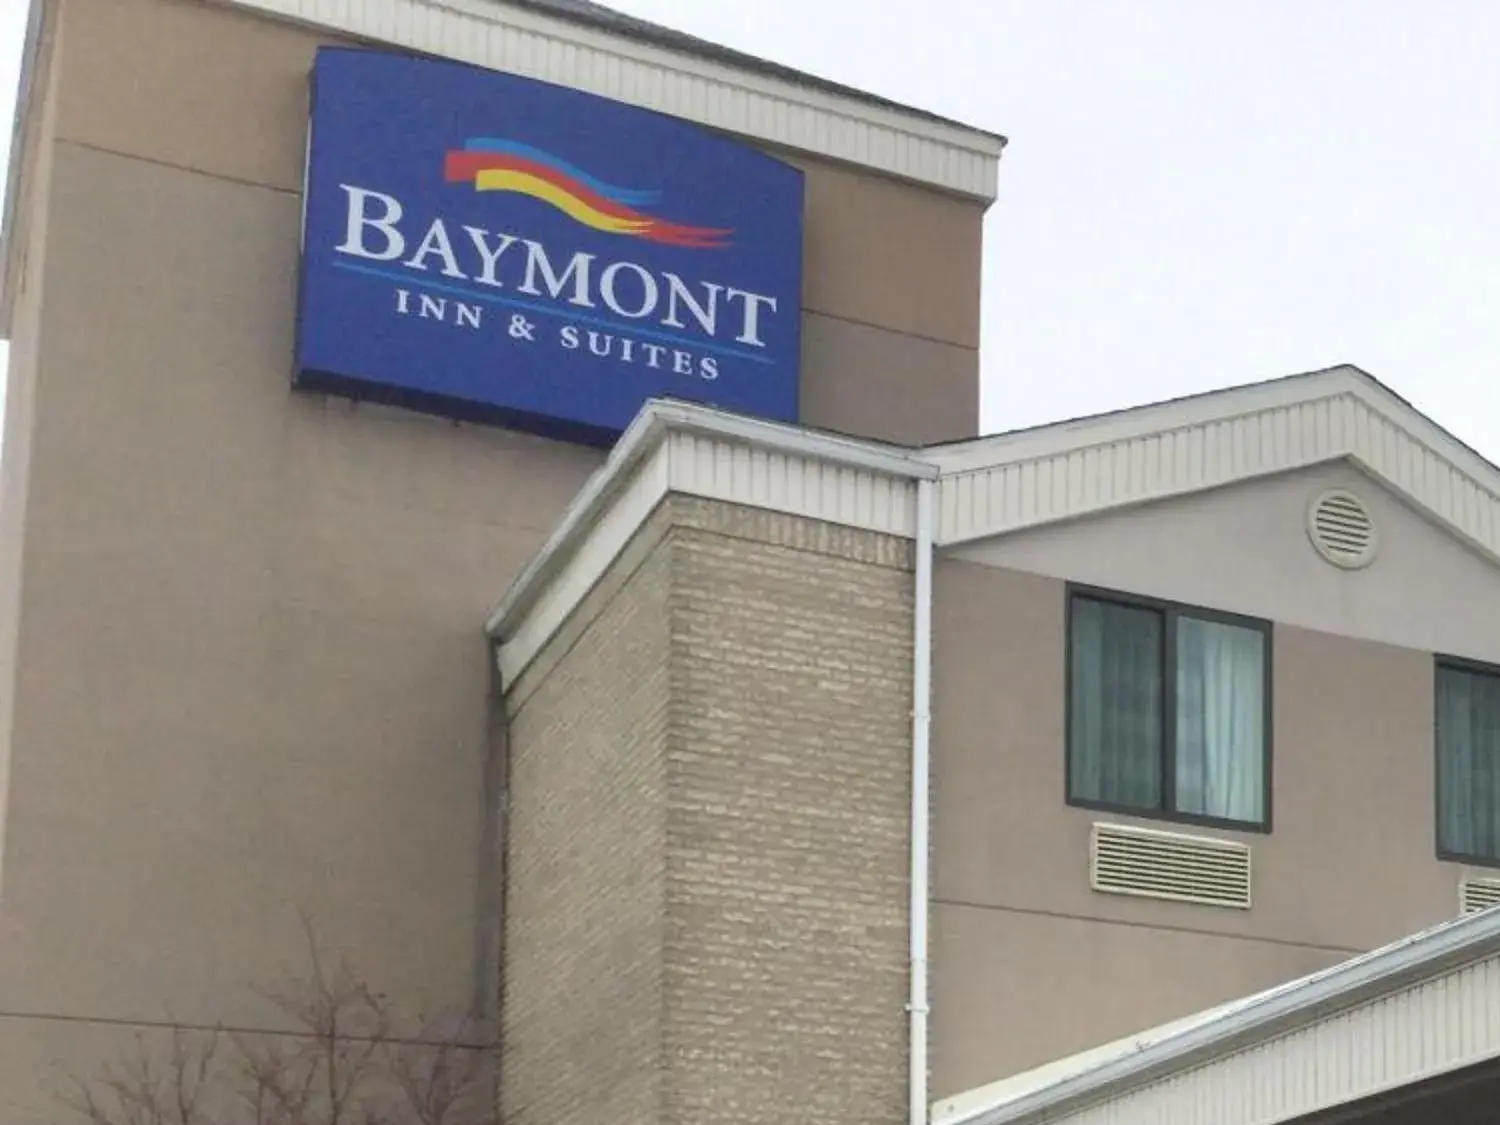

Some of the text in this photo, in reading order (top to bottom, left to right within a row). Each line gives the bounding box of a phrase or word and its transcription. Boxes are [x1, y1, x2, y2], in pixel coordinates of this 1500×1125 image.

[335, 183, 777, 348] BAYMONT
[396, 289, 720, 381] INN & SUITES
